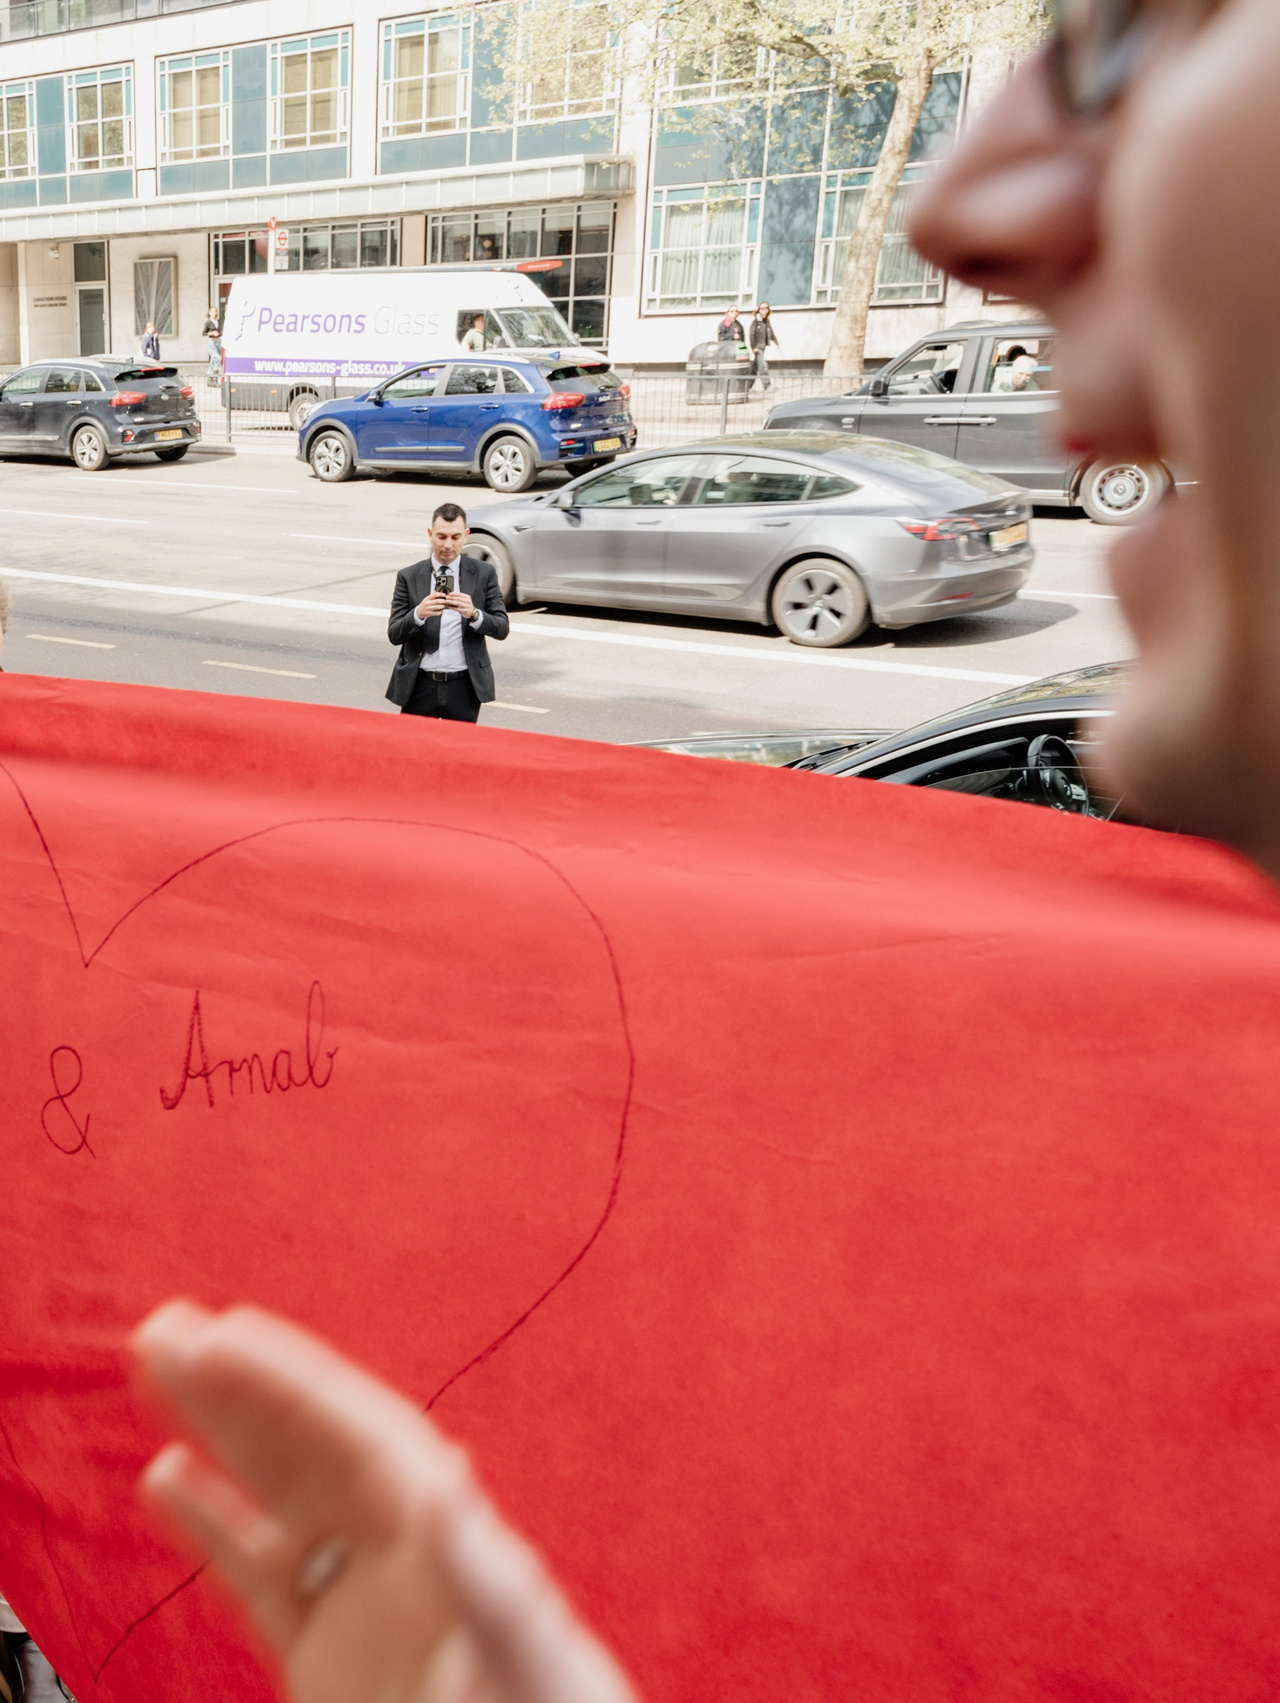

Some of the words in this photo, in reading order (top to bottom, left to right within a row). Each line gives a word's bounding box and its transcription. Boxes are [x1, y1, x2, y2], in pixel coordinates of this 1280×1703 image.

[257, 307, 367, 334] Pearsons
[374, 306, 440, 335] Glass
[254, 360, 405, 376] www.pearsons-glass.co.uk
[40, 1045, 96, 1159] &
